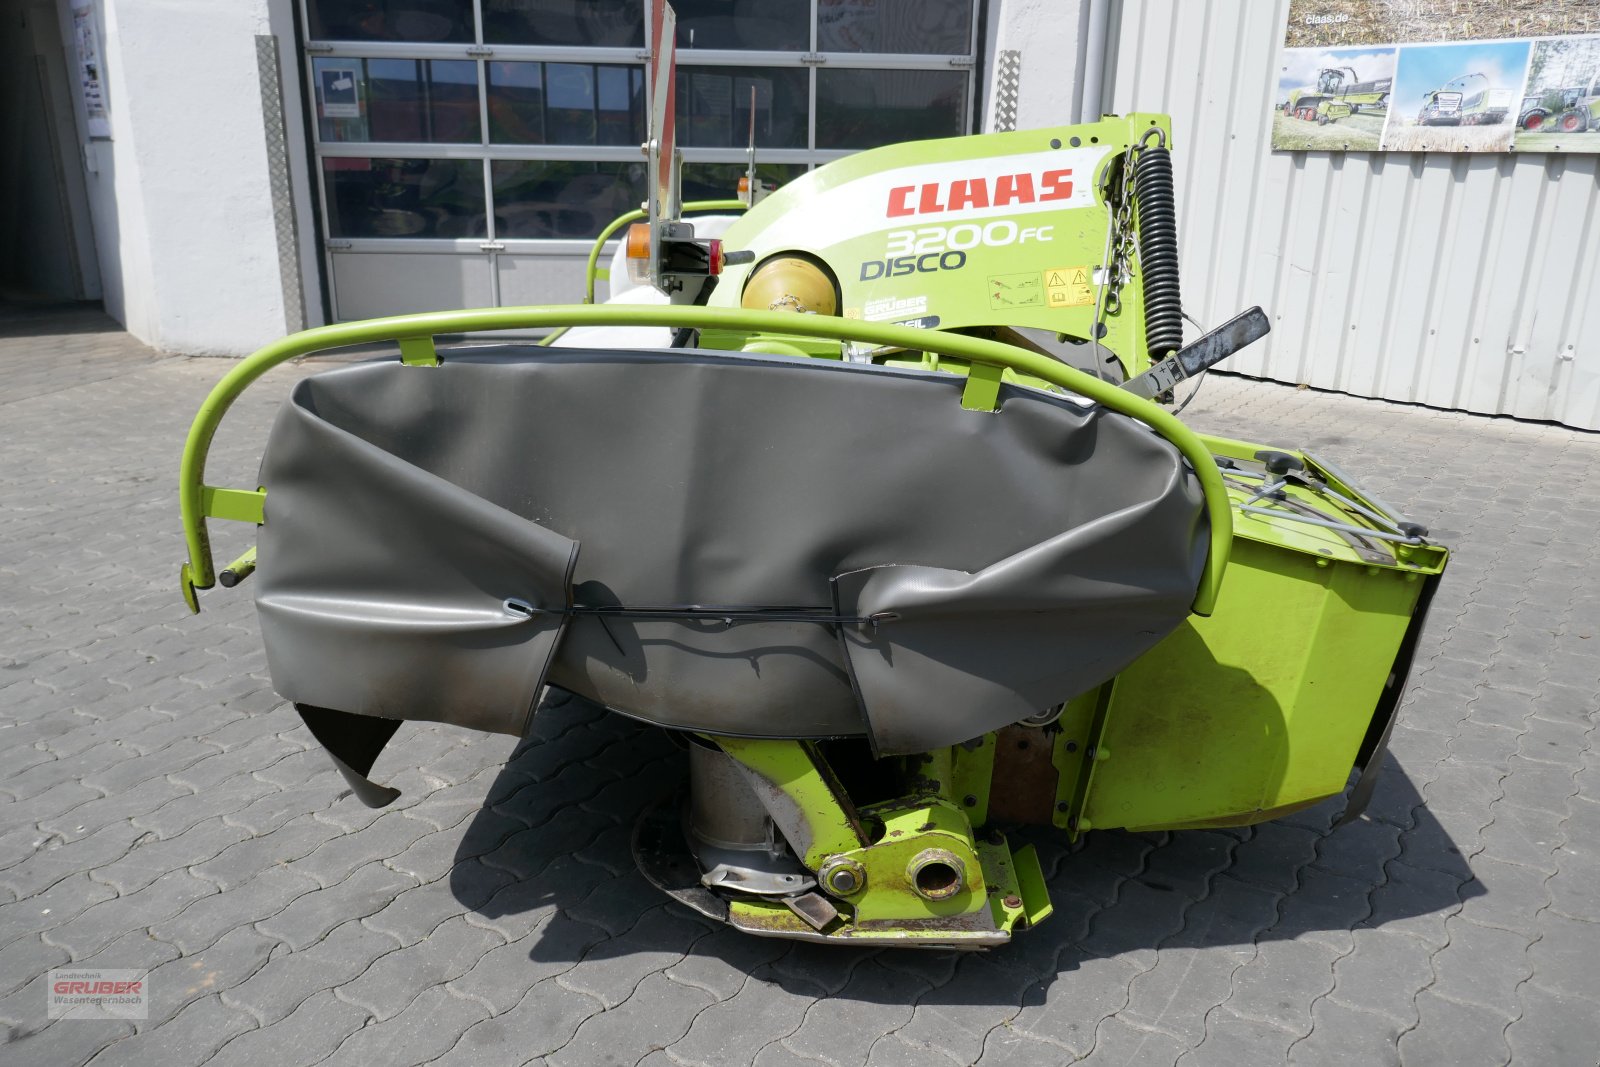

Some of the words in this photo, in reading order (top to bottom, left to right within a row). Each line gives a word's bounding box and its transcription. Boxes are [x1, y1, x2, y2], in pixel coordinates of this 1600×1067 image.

[1305, 13, 1349, 25] claas.de
[886, 168, 1074, 218] CLAAS
[859, 250, 967, 282] DISCO
[864, 296, 928, 316] GRUBER
